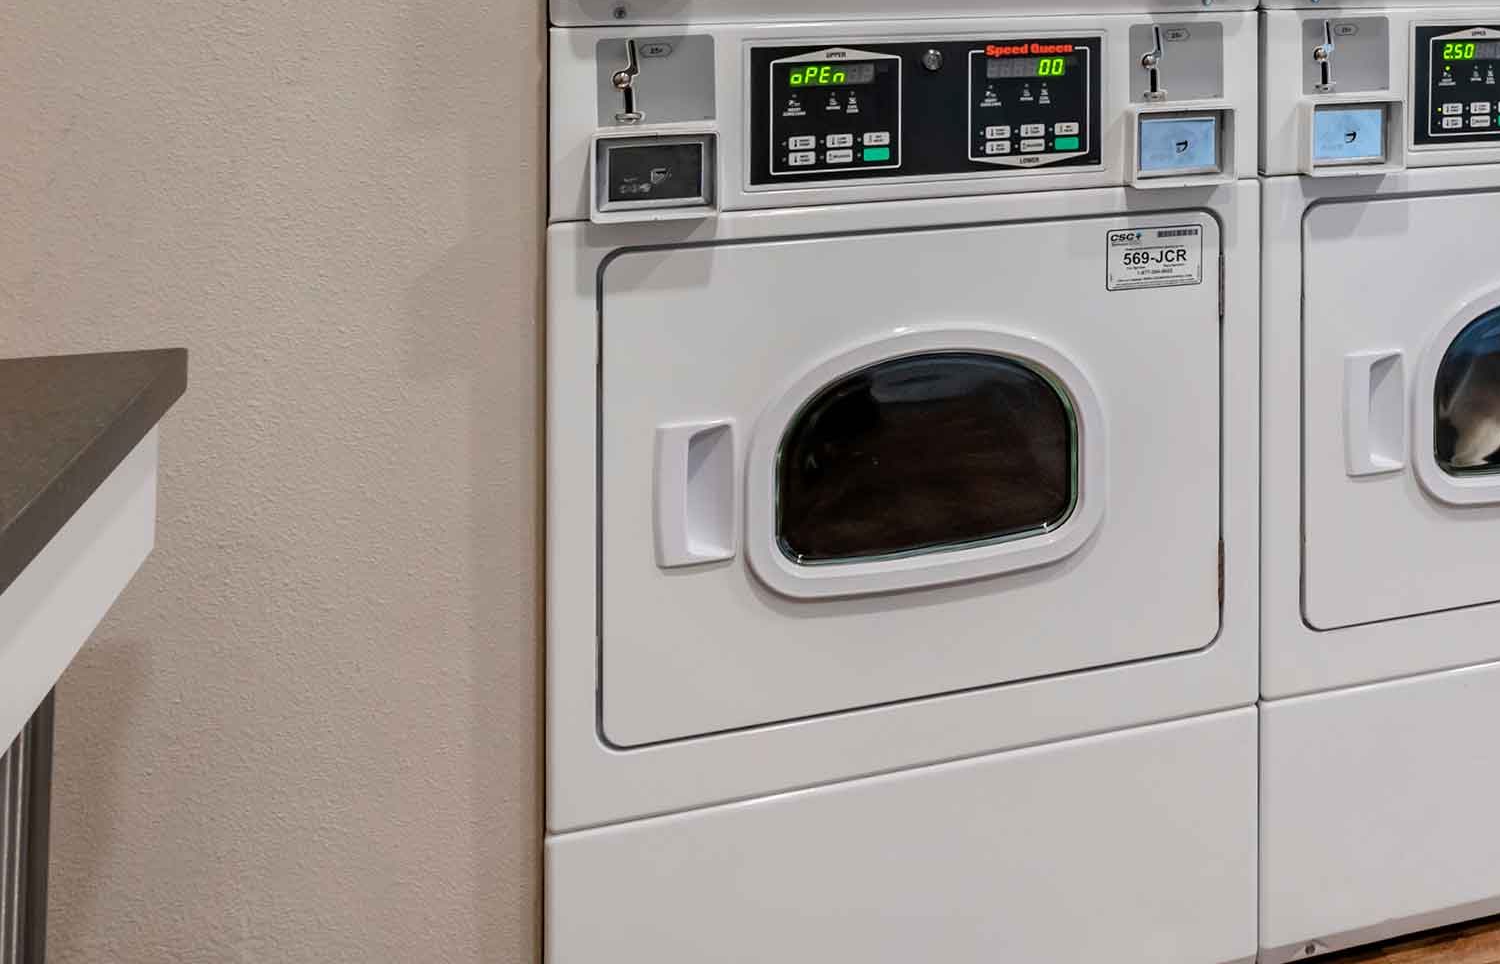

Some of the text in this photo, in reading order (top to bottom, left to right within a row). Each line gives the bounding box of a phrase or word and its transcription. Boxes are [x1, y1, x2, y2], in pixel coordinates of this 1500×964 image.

[986, 43, 1073, 58] Speed Queen
[1443, 43, 1475, 60] 2.50
[1019, 156, 1040, 164] LOWER
[1110, 232, 1135, 242] CSC
[1123, 248, 1187, 266] 569-JCR
